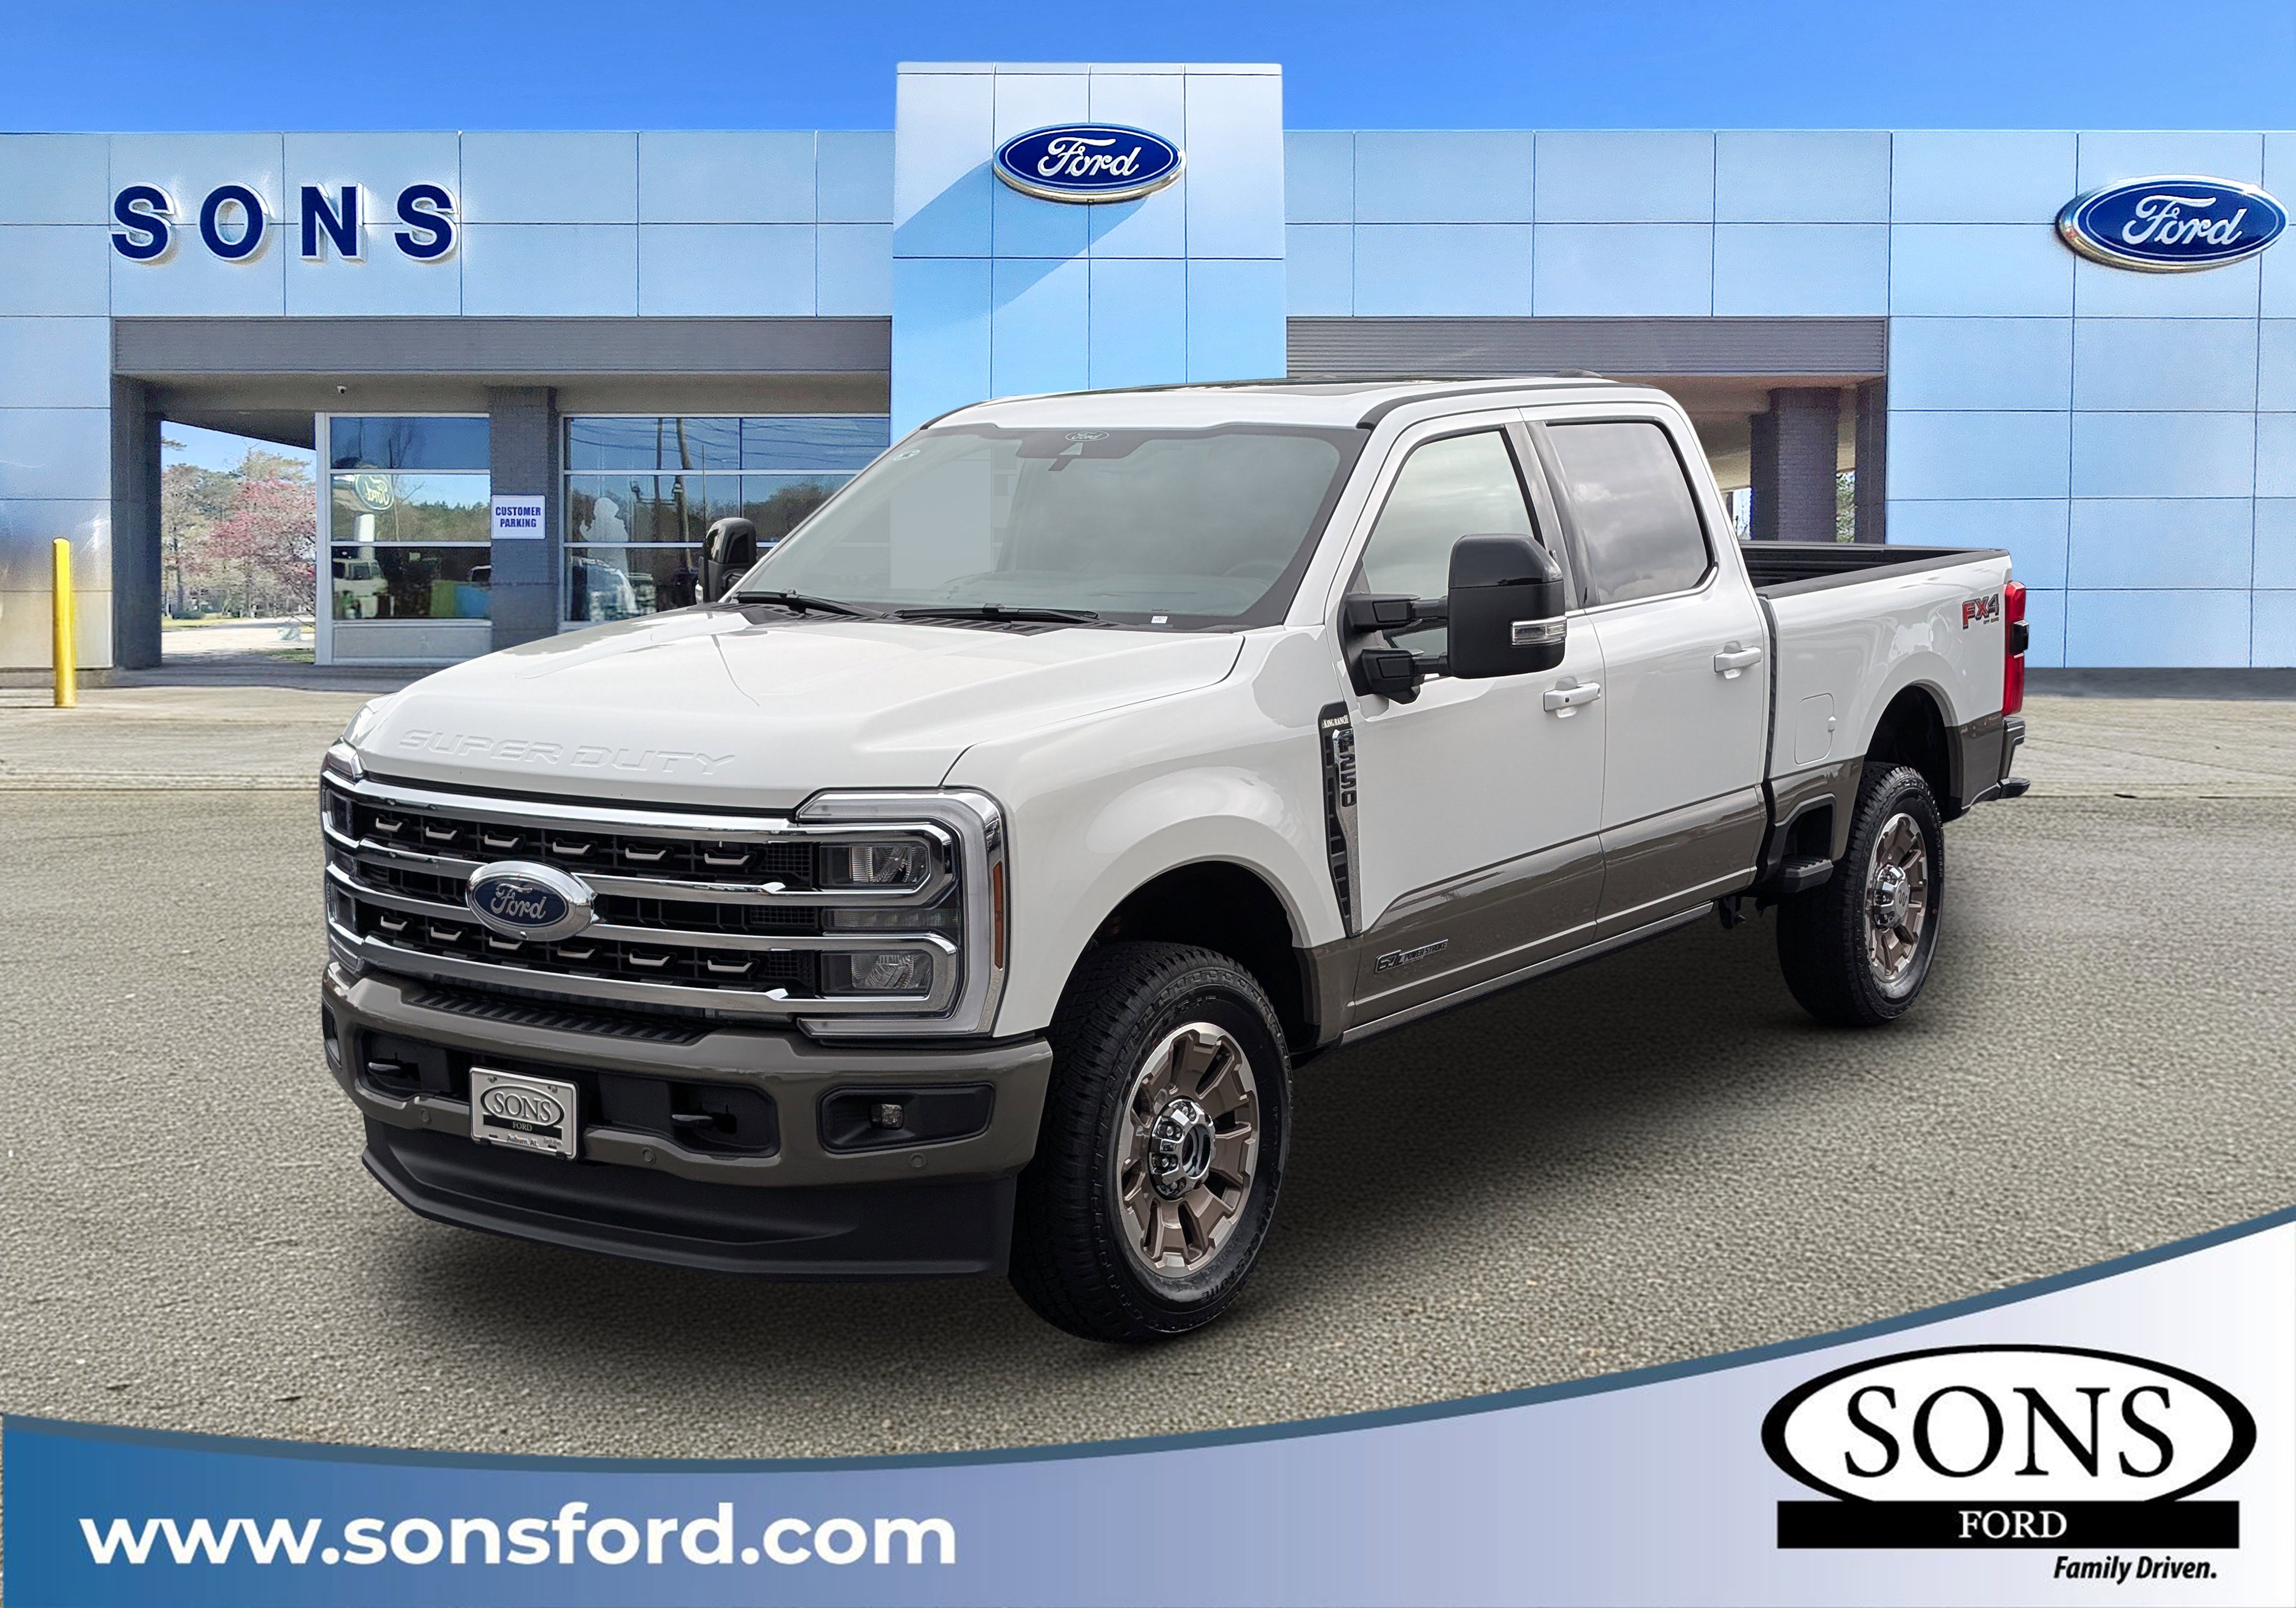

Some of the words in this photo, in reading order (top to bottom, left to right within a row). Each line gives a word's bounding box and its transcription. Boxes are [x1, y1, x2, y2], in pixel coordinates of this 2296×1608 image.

[1037, 136, 1142, 177] Ford
[111, 182, 459, 261] SONS
[2122, 195, 2248, 245] Ford
[1071, 432, 1102, 440] Ford
[495, 507, 541, 516] CUSTOMER
[500, 518, 536, 527] PARKING
[1962, 593, 1999, 630] FX4
[400, 729, 564, 764] SUPER
[571, 745, 735, 775] DUTY
[490, 883, 546, 919] Ford
[494, 1091, 551, 1121] SONS
[513, 1121, 533, 1131] FORD
